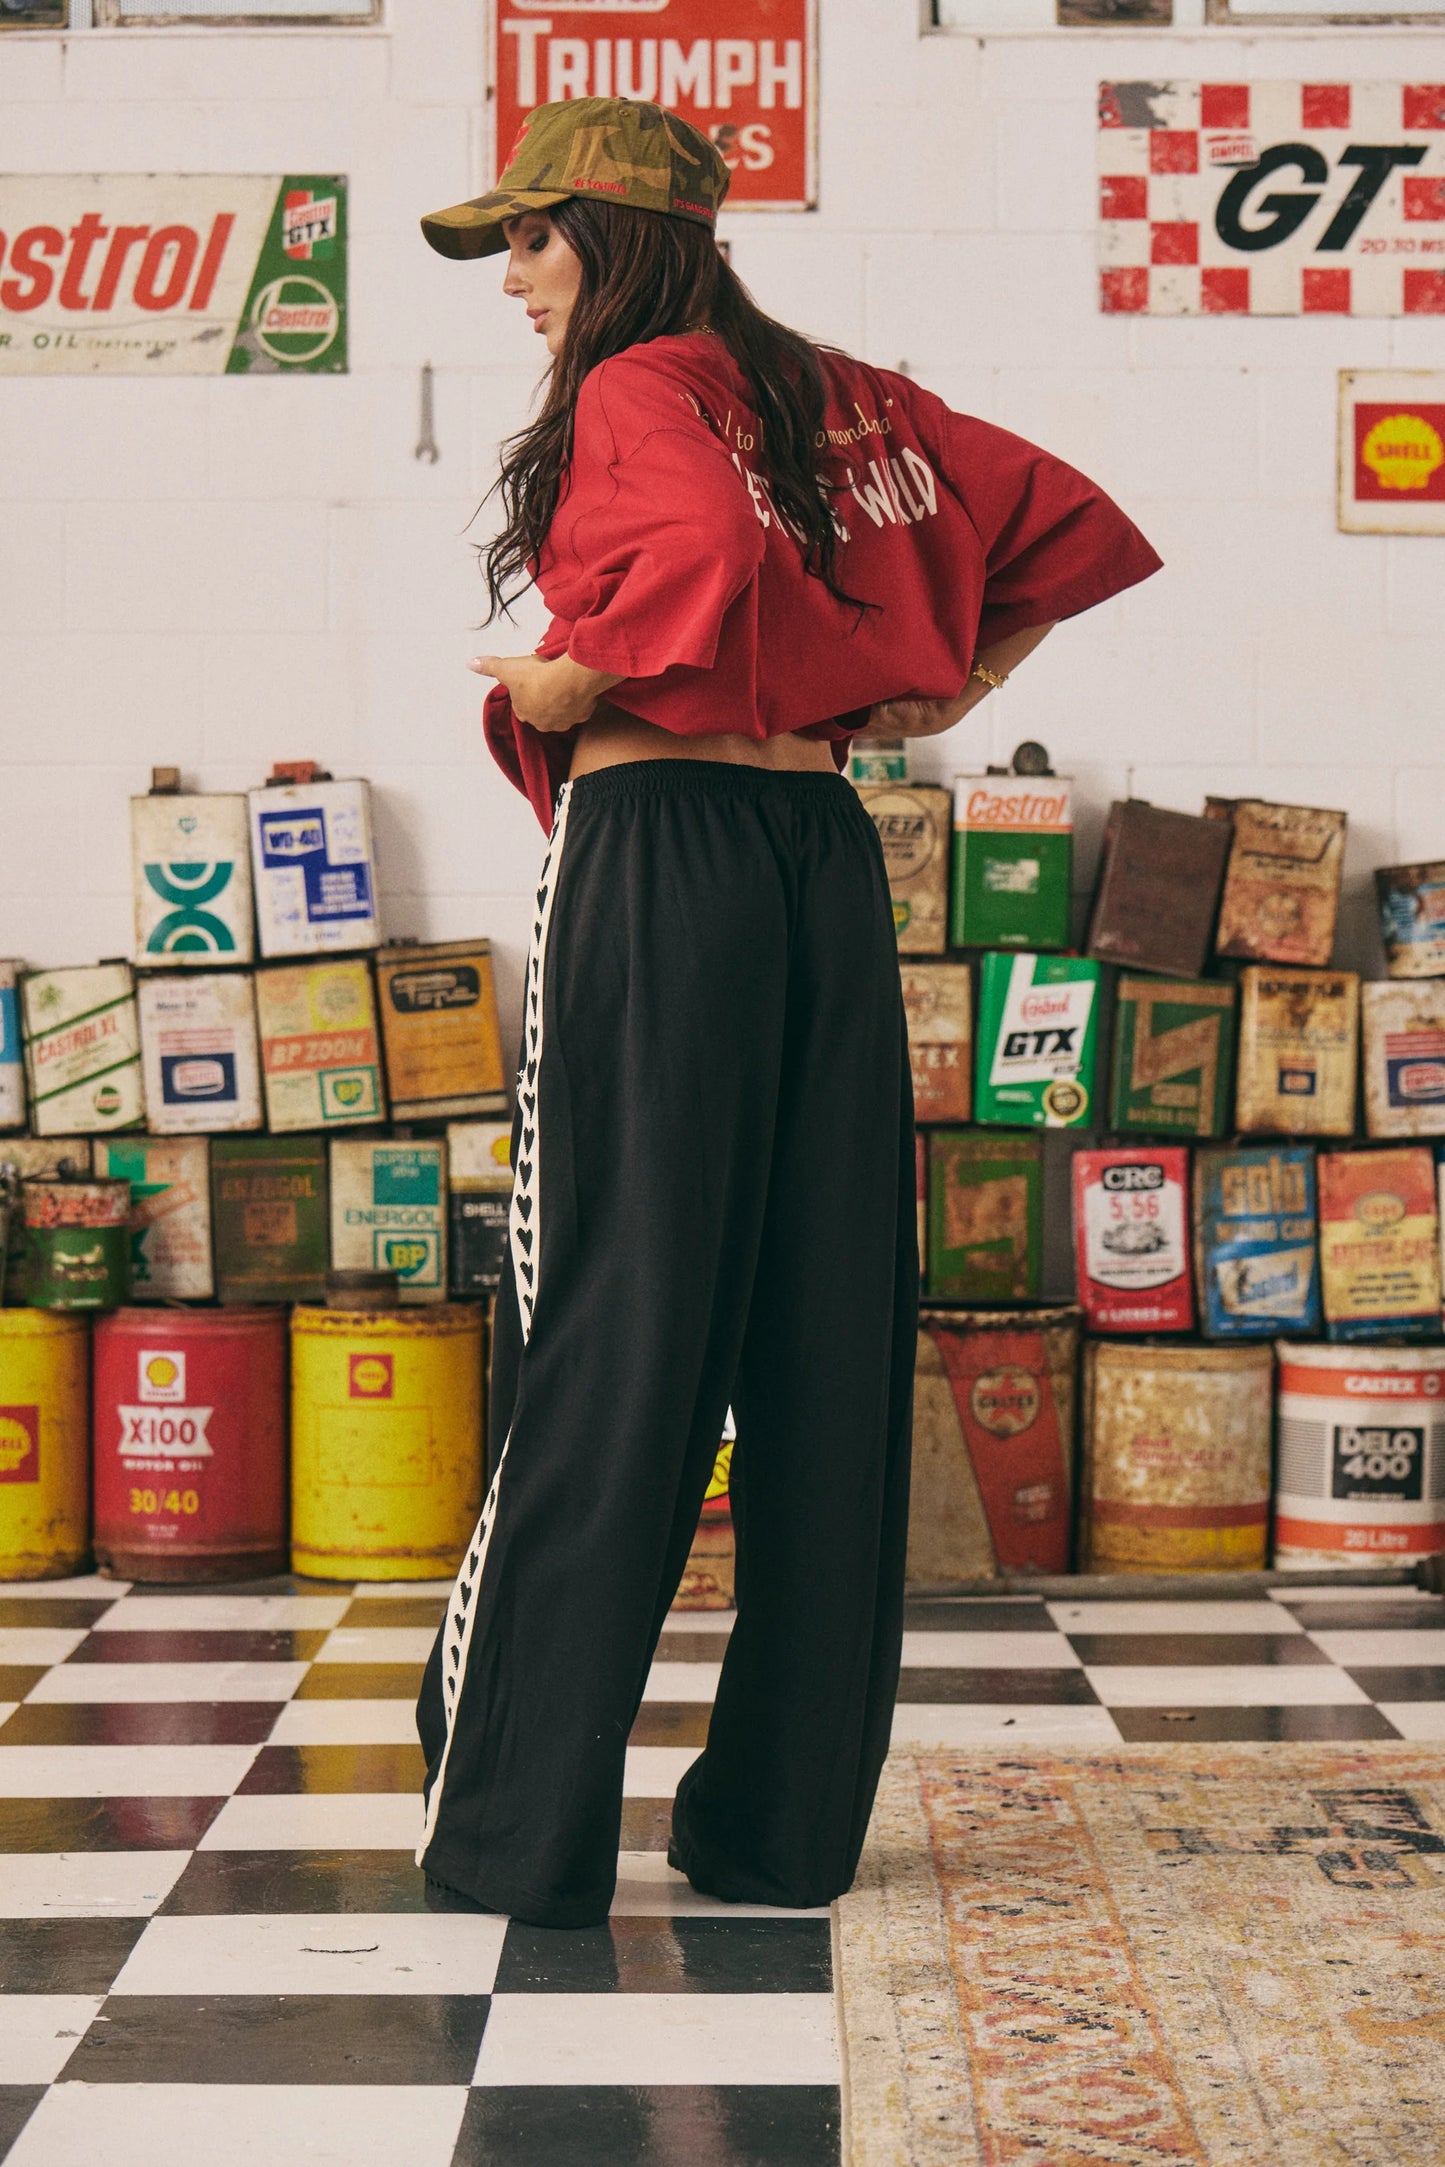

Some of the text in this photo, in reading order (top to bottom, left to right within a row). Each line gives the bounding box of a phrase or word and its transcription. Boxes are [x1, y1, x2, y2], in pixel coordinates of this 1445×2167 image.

[501, 18, 802, 109] TRIUMPH
[1215, 143, 1429, 252] GT
[289, 203, 332, 227] Castrol
[289, 219, 330, 244] GTX
[0, 213, 236, 313] strol
[265, 307, 335, 327] Castrol
[33, 333, 77, 349] OIL
[736, 426, 754, 451] to
[1376, 443, 1431, 461] SHELL
[846, 447, 938, 528] WILD
[966, 791, 1067, 823] Castrol
[269, 829, 321, 849] WD-40
[1021, 993, 1071, 1025] Castrol
[271, 1035, 366, 1066] BP ZOOM
[1003, 1027, 1078, 1057] GTX
[1104, 1167, 1162, 1189] CRC
[345, 1208, 435, 1227] ENERGOL
[392, 1243, 427, 1269] BP
[1344, 1375, 1415, 1394] CALTEX
[1339, 1427, 1418, 1456] DELO
[122, 1458, 203, 1472] MOTOR OIL
[1343, 1455, 1412, 1480] 400
[129, 1487, 200, 1515] 30/40
[1344, 1529, 1367, 1548] 20
